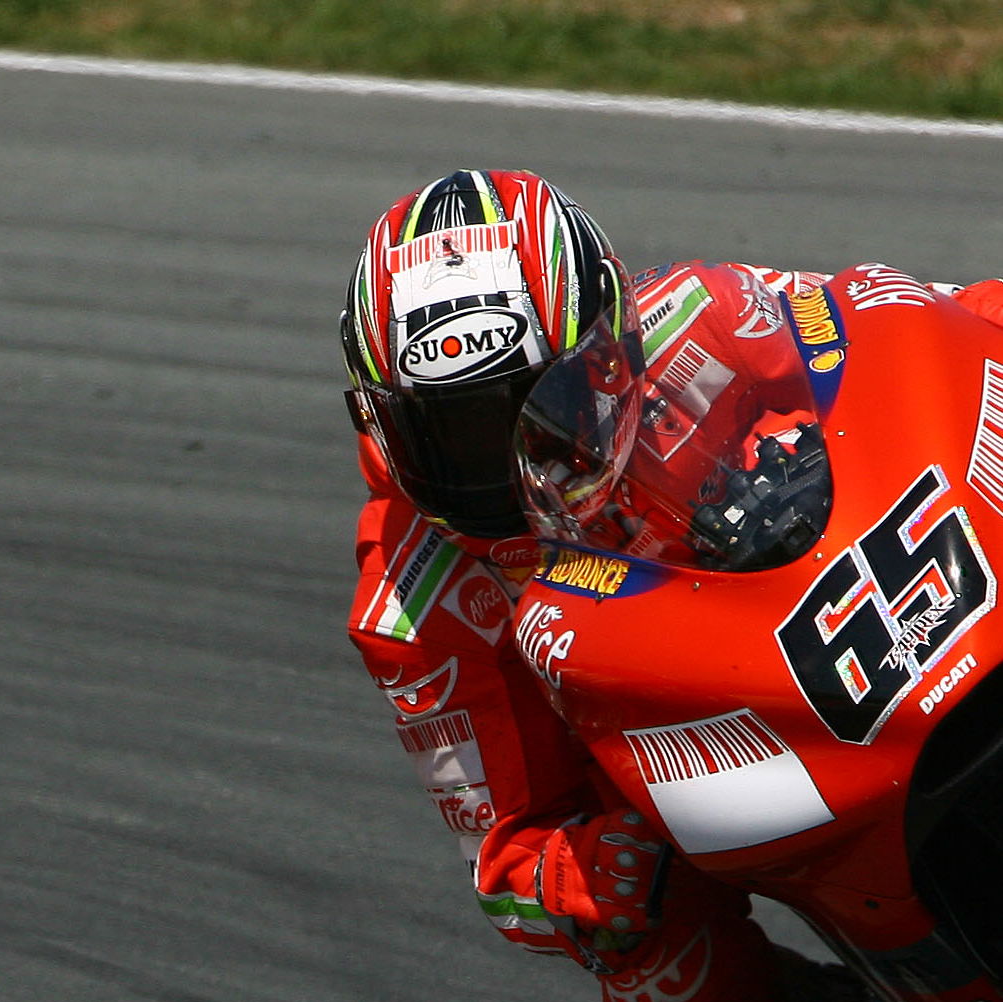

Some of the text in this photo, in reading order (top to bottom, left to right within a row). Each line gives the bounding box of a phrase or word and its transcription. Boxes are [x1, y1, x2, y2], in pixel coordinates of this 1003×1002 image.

[640, 298, 675, 334] TONE
[407, 326, 515, 365] SUOMY
[547, 551, 631, 595] ADVANCE
[774, 464, 997, 746] 65
[516, 601, 576, 690] Alice
[918, 653, 979, 716] DUCATI
[438, 795, 496, 833] lice
